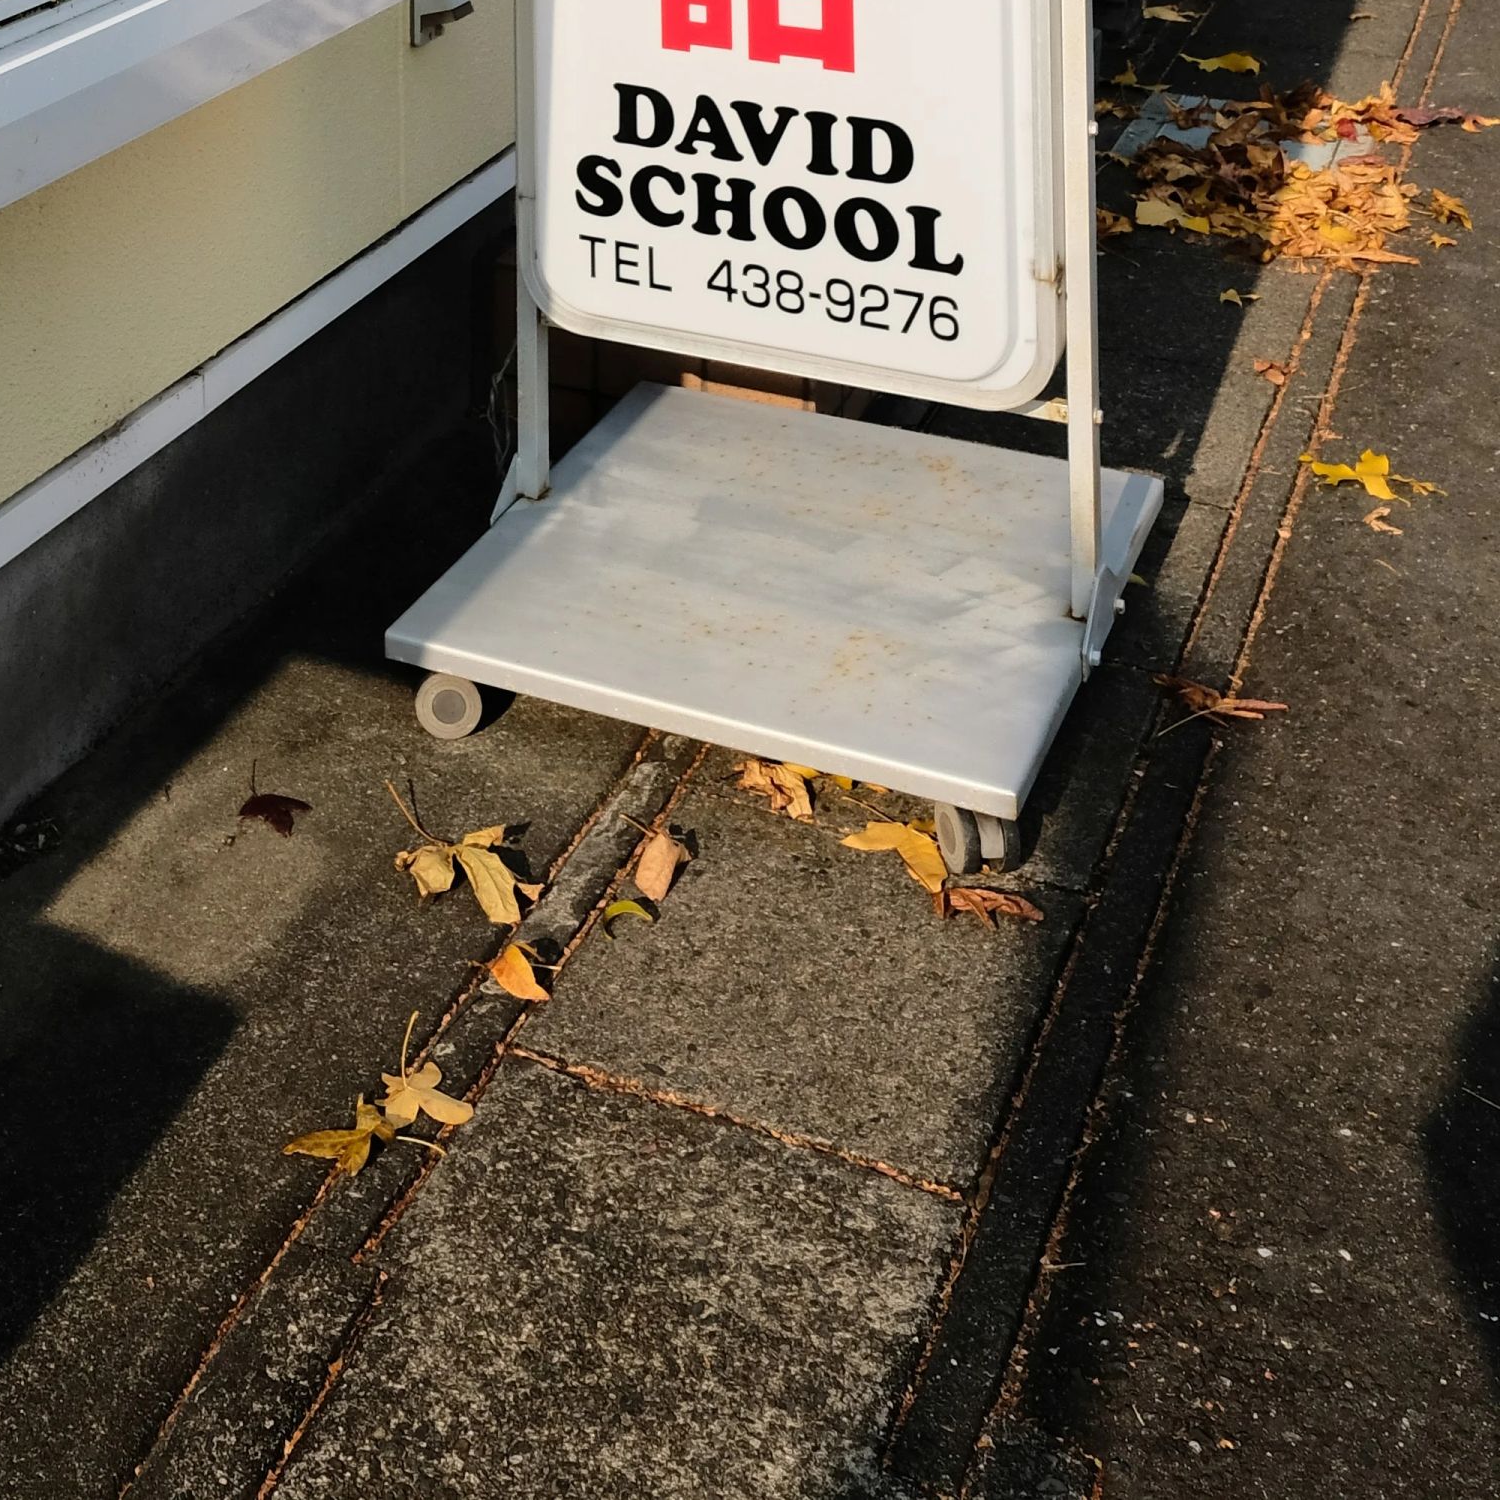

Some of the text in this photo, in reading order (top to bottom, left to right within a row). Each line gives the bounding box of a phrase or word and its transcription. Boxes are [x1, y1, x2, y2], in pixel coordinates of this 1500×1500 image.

[613, 82, 914, 184] DAVID
[575, 154, 964, 276] SCHOOL
[579, 234, 961, 342] TEL 438-9276
